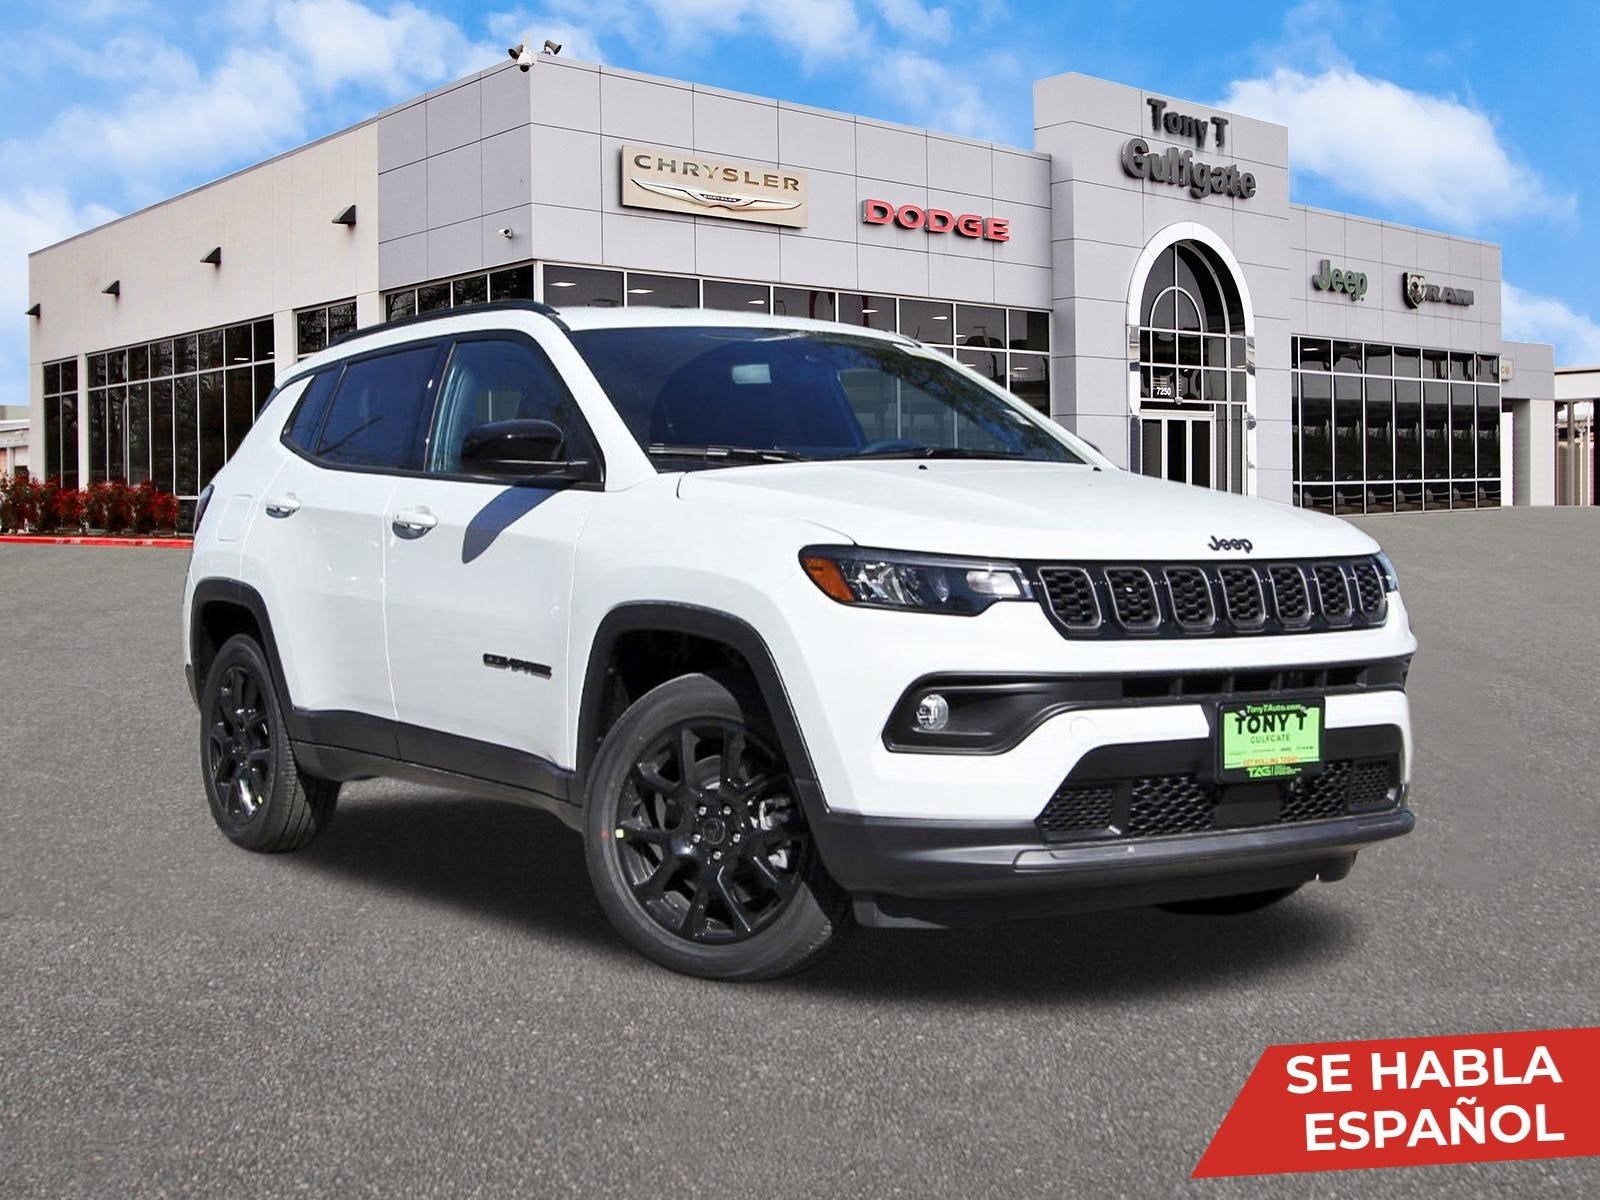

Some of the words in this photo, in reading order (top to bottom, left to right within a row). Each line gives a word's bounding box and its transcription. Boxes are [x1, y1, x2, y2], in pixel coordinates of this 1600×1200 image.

[1146, 97, 1209, 148] Tony
[1210, 116, 1229, 148] T
[633, 154, 801, 192] CHRYSLER
[1121, 137, 1257, 199] Gulfgate
[862, 198, 1010, 242] DODGE
[1312, 259, 1369, 302] Jeep
[1425, 283, 1475, 307] RAM
[1156, 386, 1172, 396] 7250
[1207, 535, 1253, 555] Jeep
[1235, 711, 1290, 735] TONY
[1296, 709, 1308, 731] T
